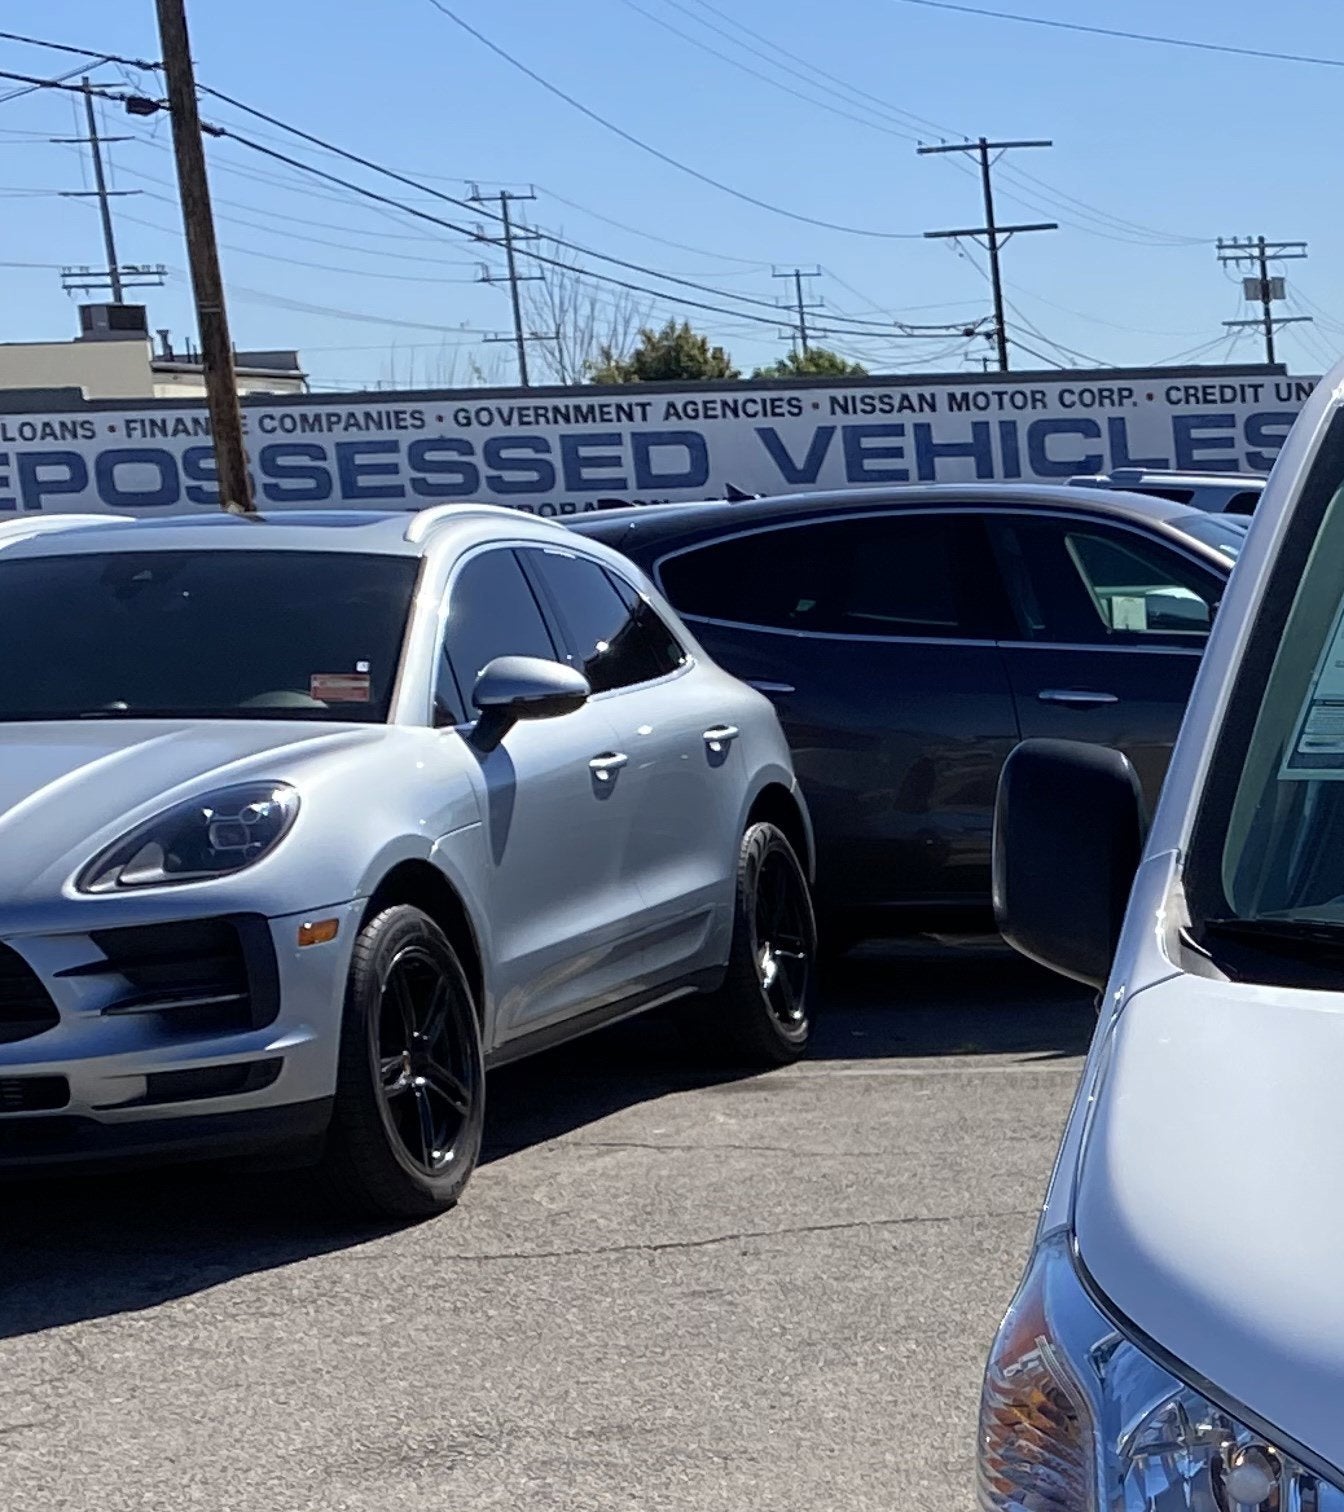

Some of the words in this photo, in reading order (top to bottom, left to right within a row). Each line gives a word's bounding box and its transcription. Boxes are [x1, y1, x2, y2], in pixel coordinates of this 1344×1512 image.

[1, 420, 97, 442] LOANS
[124, 415, 249, 439] FINANE
[258, 409, 426, 434] COMPANIES
[453, 402, 650, 427] GOVERNMENT
[663, 396, 803, 421] AGENCIES
[829, 392, 937, 417] NISSAN
[947, 389, 1048, 412] MOTOR
[1058, 386, 1138, 409] CORP.
[1165, 383, 1265, 405] CREDIT
[0, 430, 709, 511] POSSESSED
[754, 411, 1299, 485] VEHICLES
